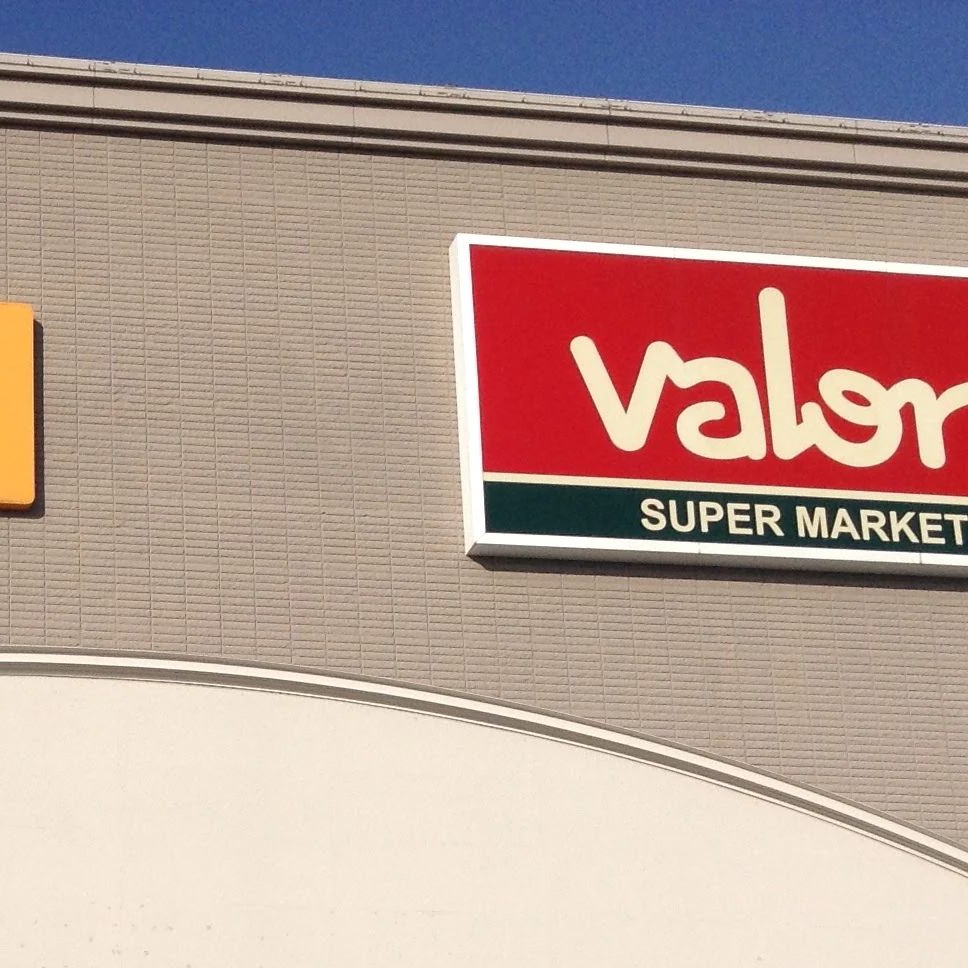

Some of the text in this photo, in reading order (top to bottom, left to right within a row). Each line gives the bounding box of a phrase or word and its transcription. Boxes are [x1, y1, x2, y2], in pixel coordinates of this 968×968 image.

[570, 287, 968, 469] valor
[639, 498, 968, 545] SUPER MARKET
